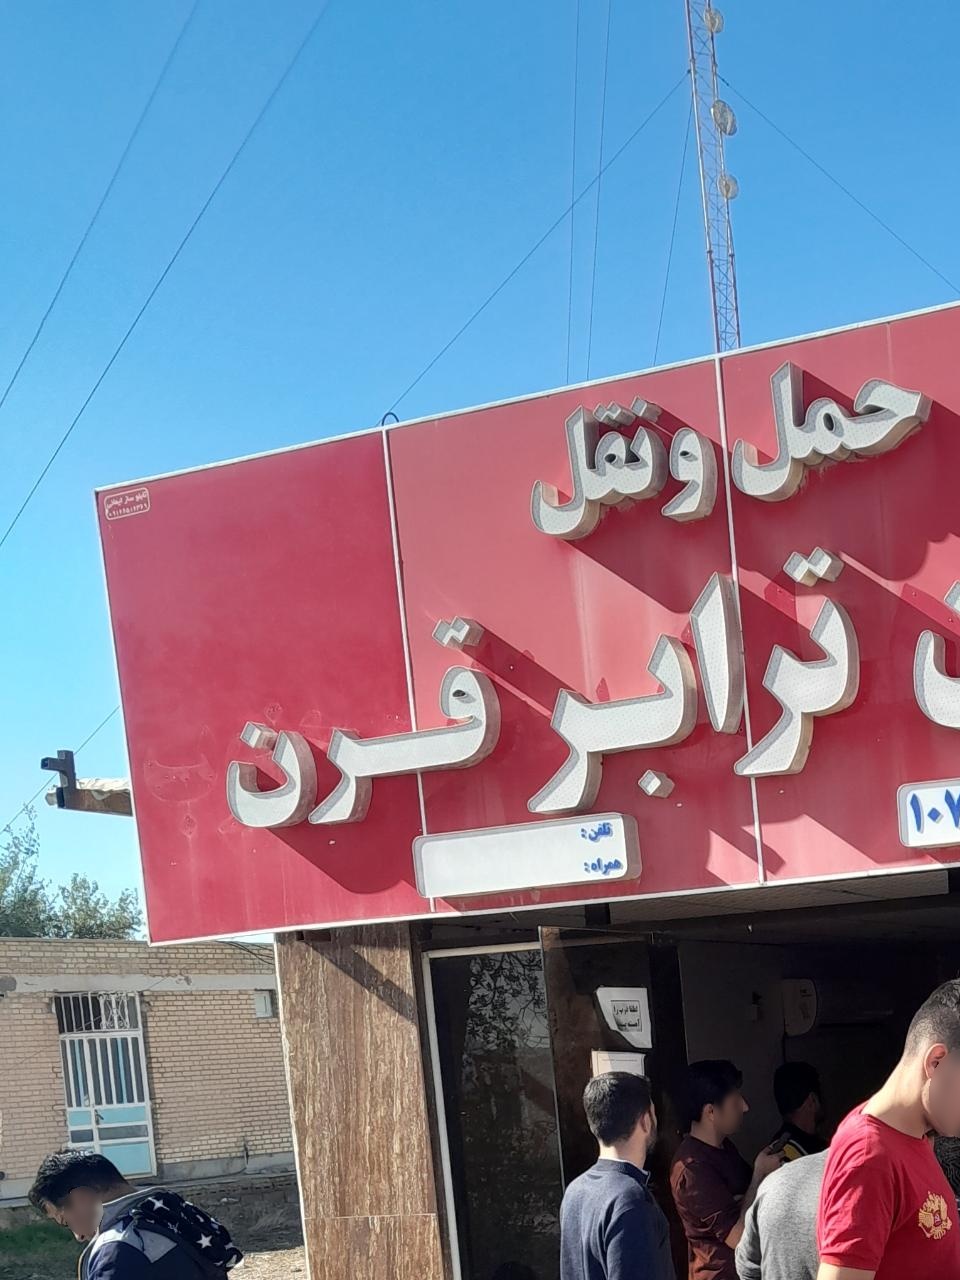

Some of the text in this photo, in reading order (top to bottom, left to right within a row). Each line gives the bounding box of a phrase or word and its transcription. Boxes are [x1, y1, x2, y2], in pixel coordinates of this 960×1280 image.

[530, 361, 933, 540] حمل و نقل
[226, 616, 501, 829] قرن
[527, 547, 860, 813] ترابر
